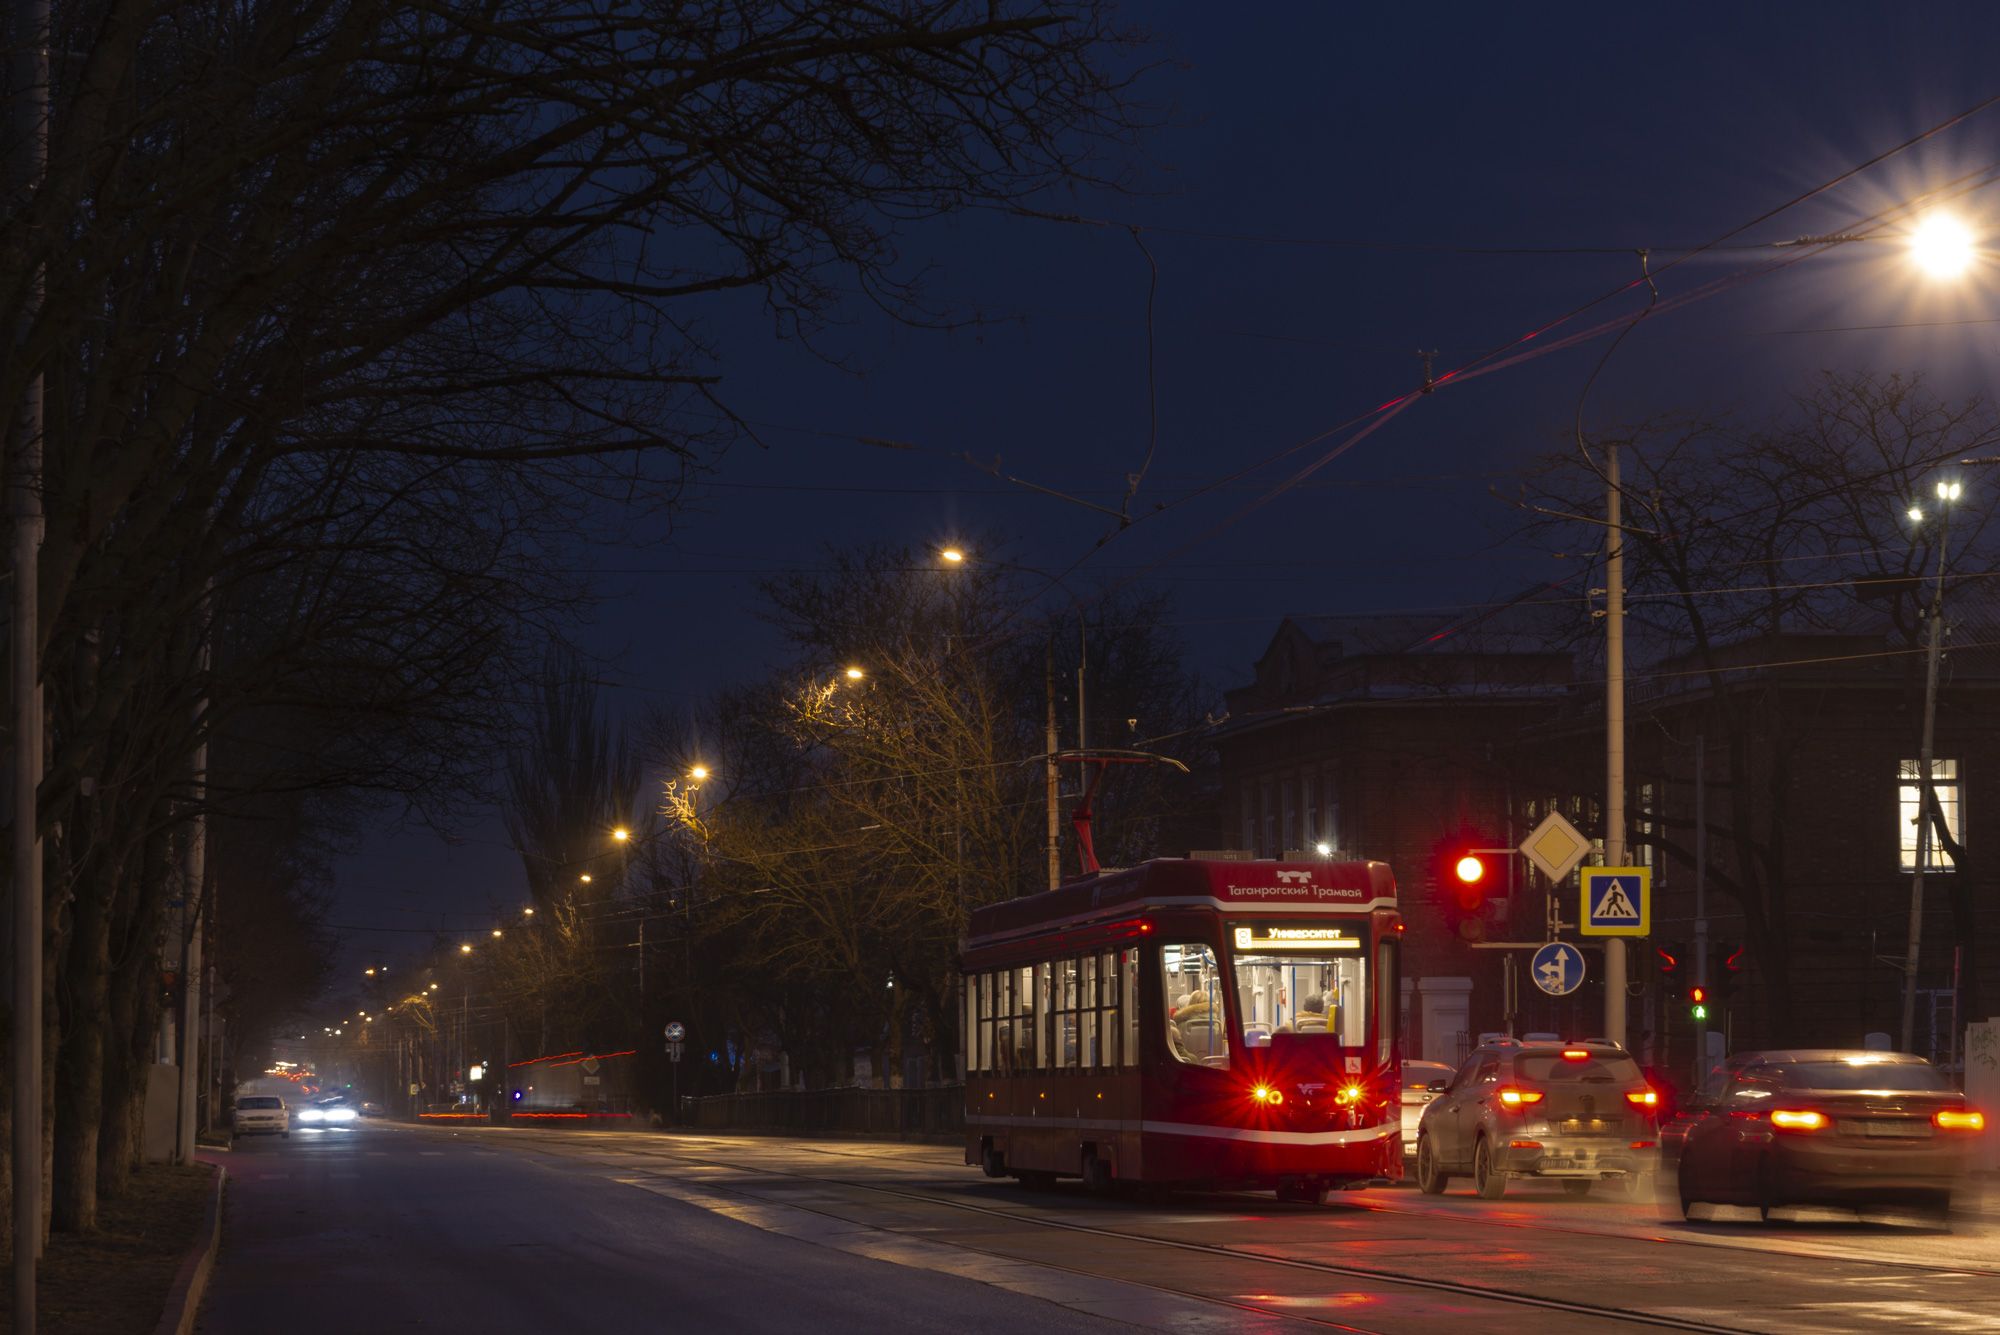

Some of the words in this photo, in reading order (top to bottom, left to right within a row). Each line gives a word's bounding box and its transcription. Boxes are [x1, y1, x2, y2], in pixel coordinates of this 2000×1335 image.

[1228, 885, 1308, 897] Таганрогский
[1312, 885, 1362, 898] Трамвай
[1268, 928, 1341, 938] Университет
